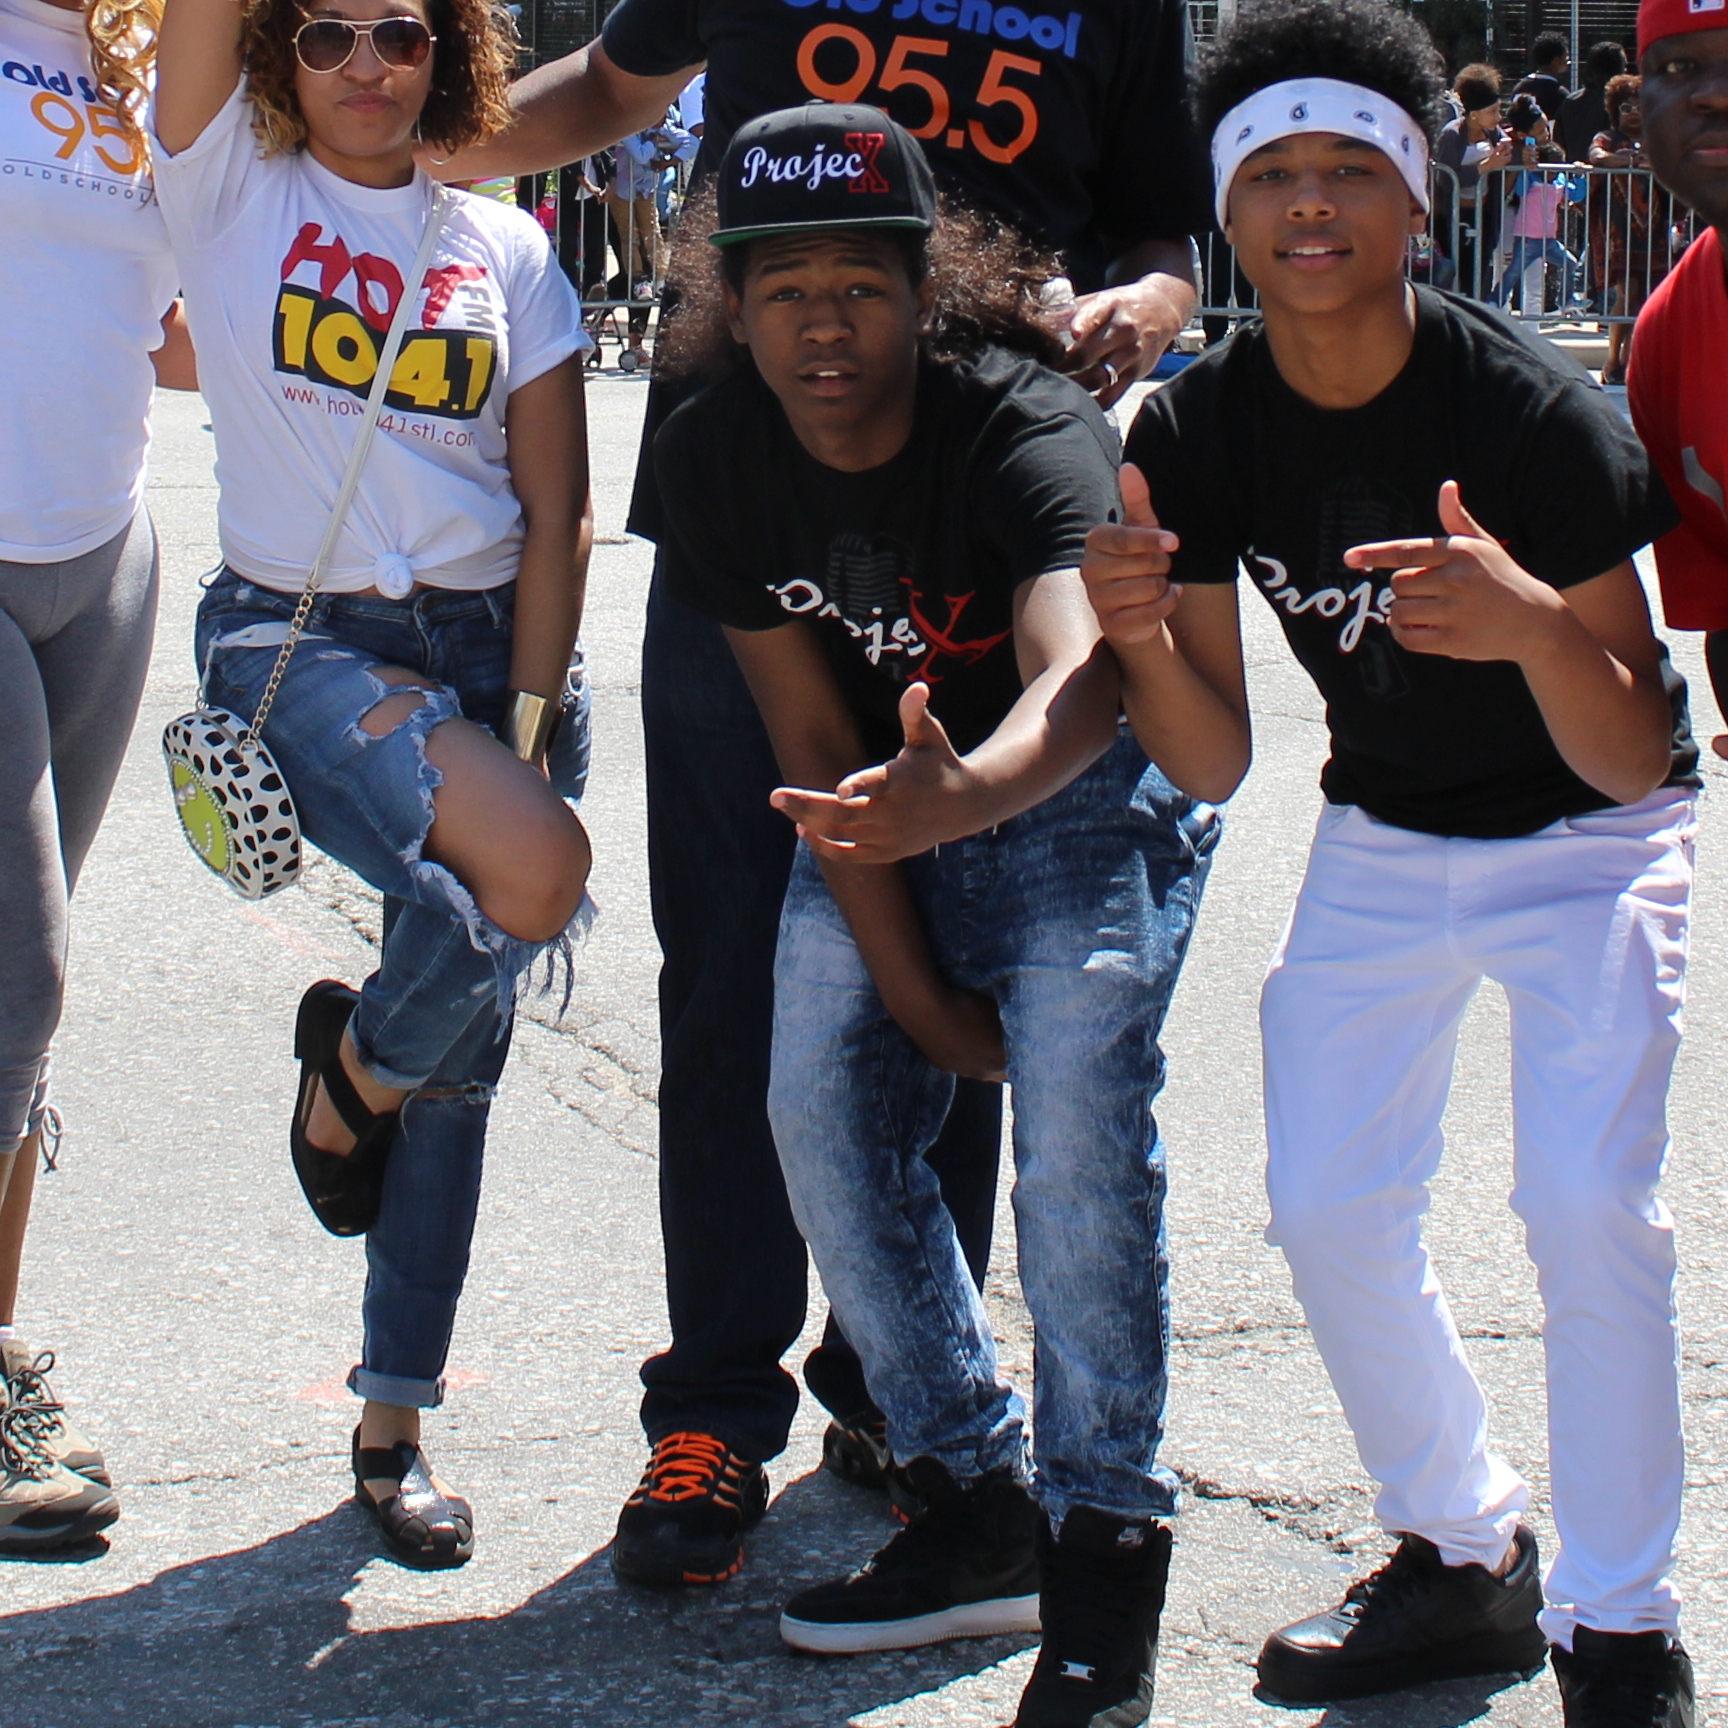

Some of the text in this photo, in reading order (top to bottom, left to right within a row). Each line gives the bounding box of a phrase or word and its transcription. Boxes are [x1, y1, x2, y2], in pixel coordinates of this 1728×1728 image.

[2, 61, 73, 97] Old
[796, 23, 1043, 165] 95.5
[281, 222, 489, 333] HOT
[458, 285, 495, 330] FM
[278, 293, 494, 411] 104.1
